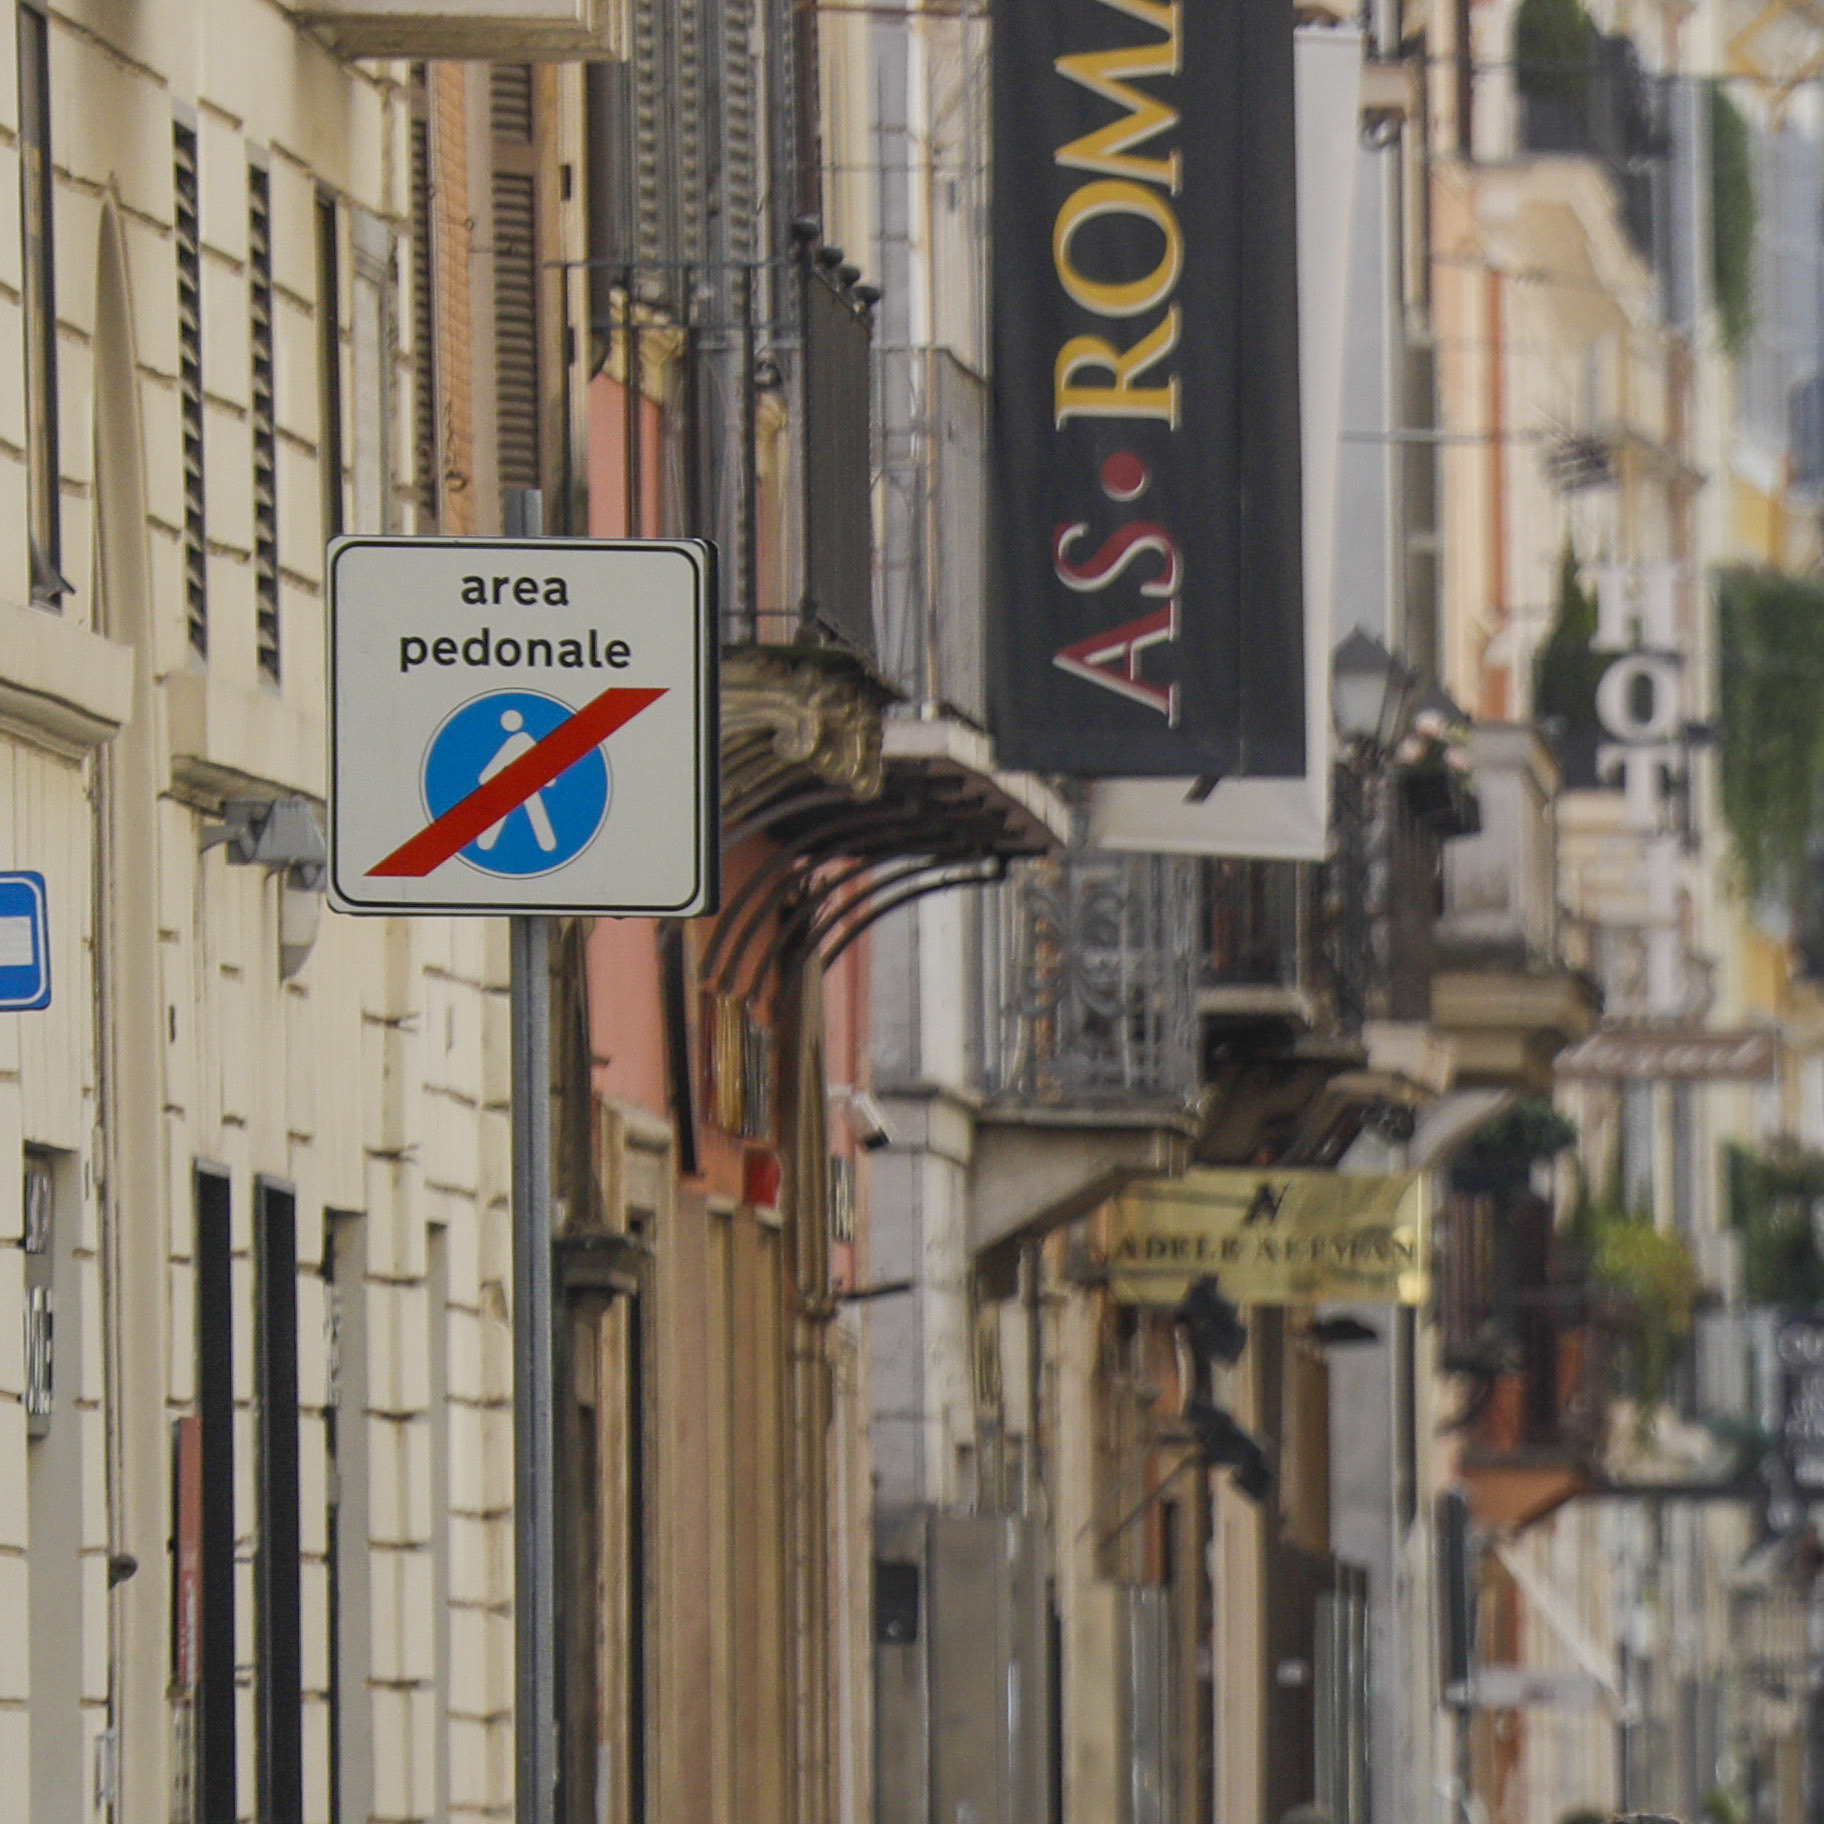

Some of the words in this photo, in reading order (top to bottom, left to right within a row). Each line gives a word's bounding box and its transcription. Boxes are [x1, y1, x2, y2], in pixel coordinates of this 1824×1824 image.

[461, 575, 569, 606] area
[1052, 522, 1184, 730] AS
[400, 627, 631, 672] pedonale
